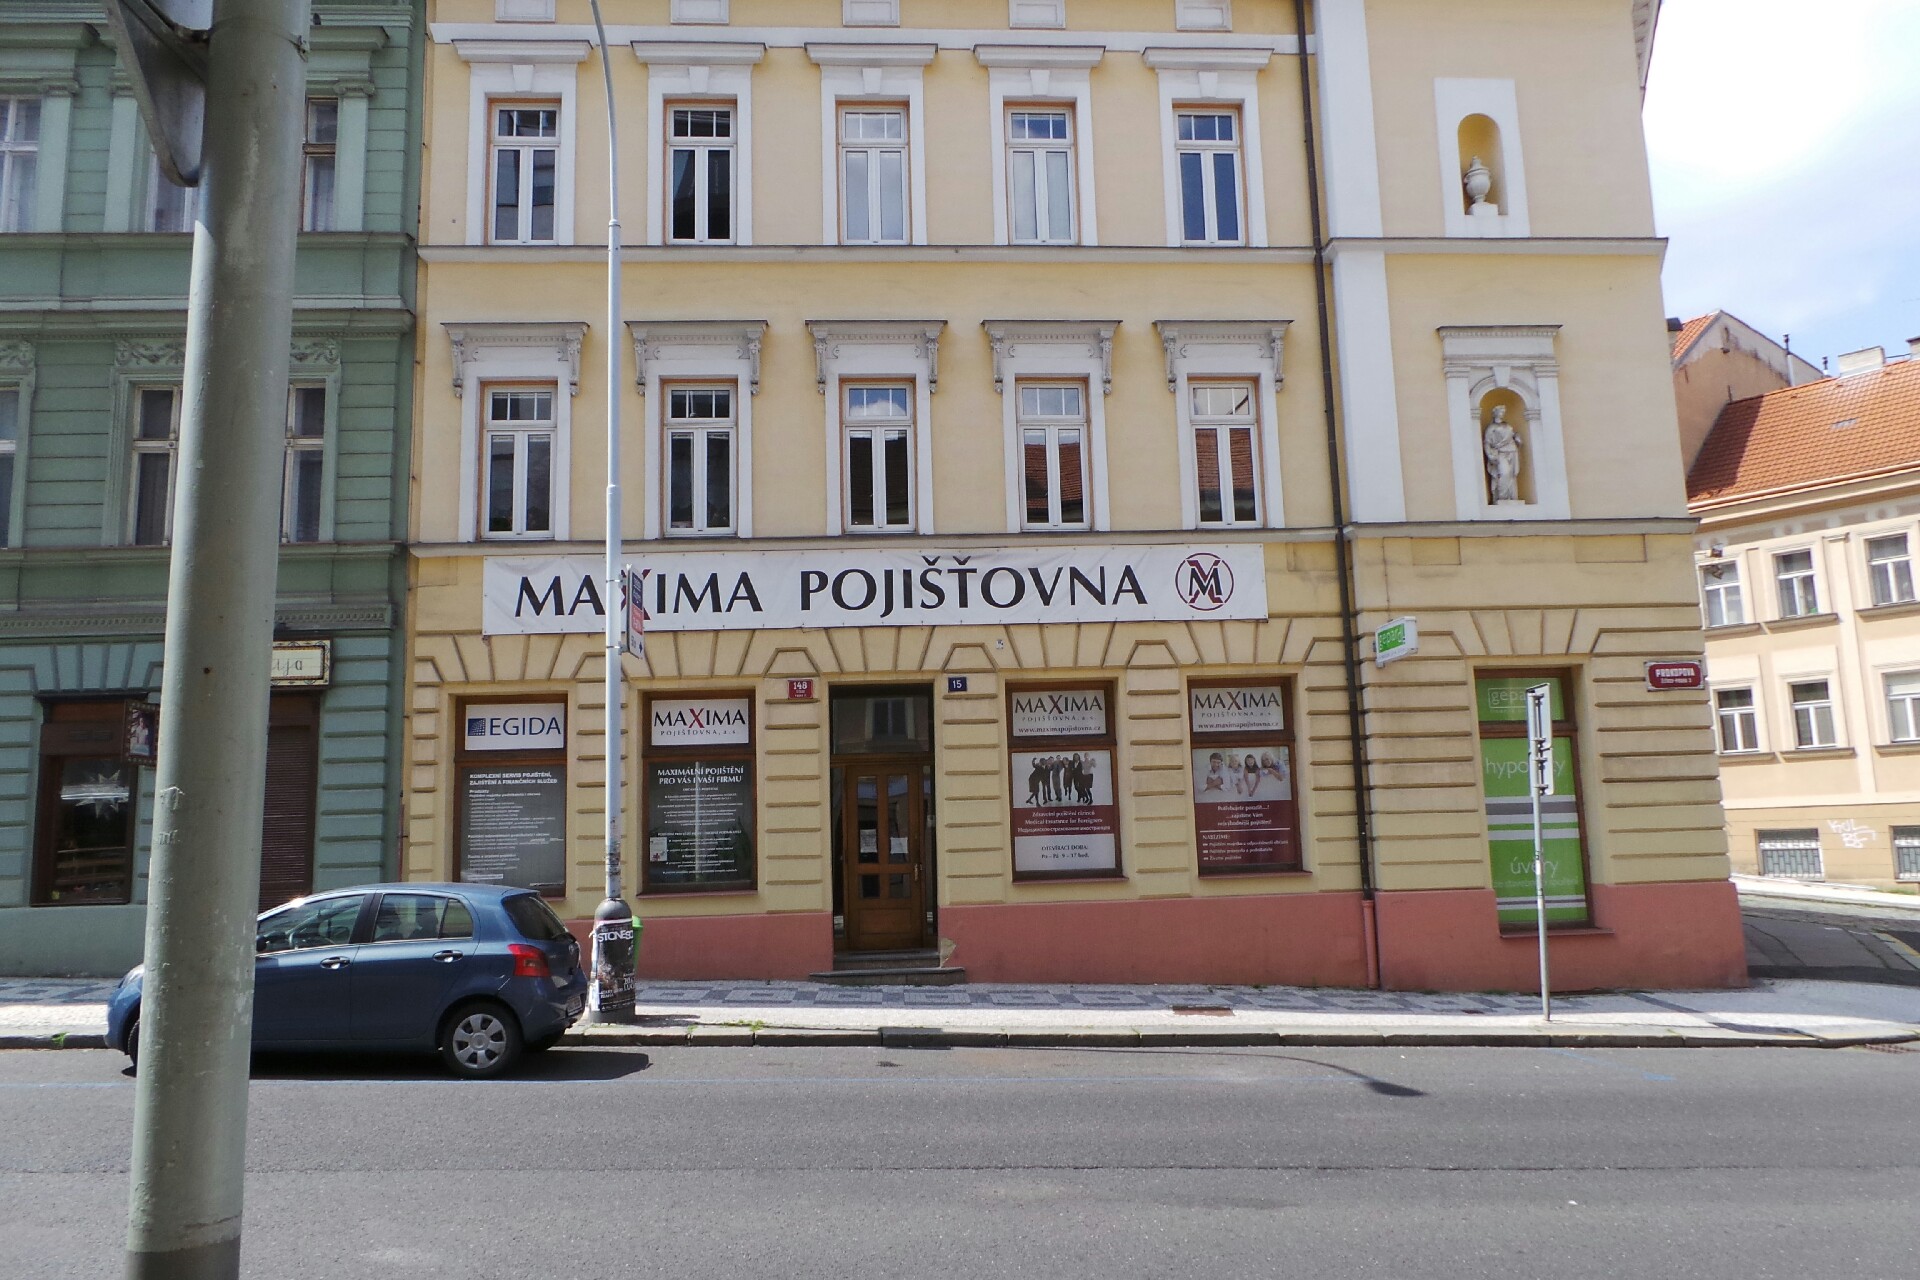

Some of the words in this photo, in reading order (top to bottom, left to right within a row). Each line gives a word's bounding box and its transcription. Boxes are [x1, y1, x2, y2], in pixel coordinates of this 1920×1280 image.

[801, 556, 1148, 618] POJIŠŤOVNA
[1655, 667, 1695, 677] PROKOPOVA
[793, 681, 808, 690] 148
[952, 679, 962, 689] 15
[1014, 694, 1103, 715] MAXIMA
[1194, 691, 1281, 710] MAXIMA
[1491, 690, 1527, 705] gepa
[489, 716, 562, 736] EGIDA
[654, 707, 746, 729] MAXIMA
[657, 766, 704, 776] MAXIMÁLNÍ
[705, 765, 744, 775] POJIŠTĚNÍ
[1485, 757, 1565, 779] hypoy
[659, 777, 675, 785] PRO
[677, 776, 692, 784] VÁS
[716, 775, 742, 783] FIRMU
